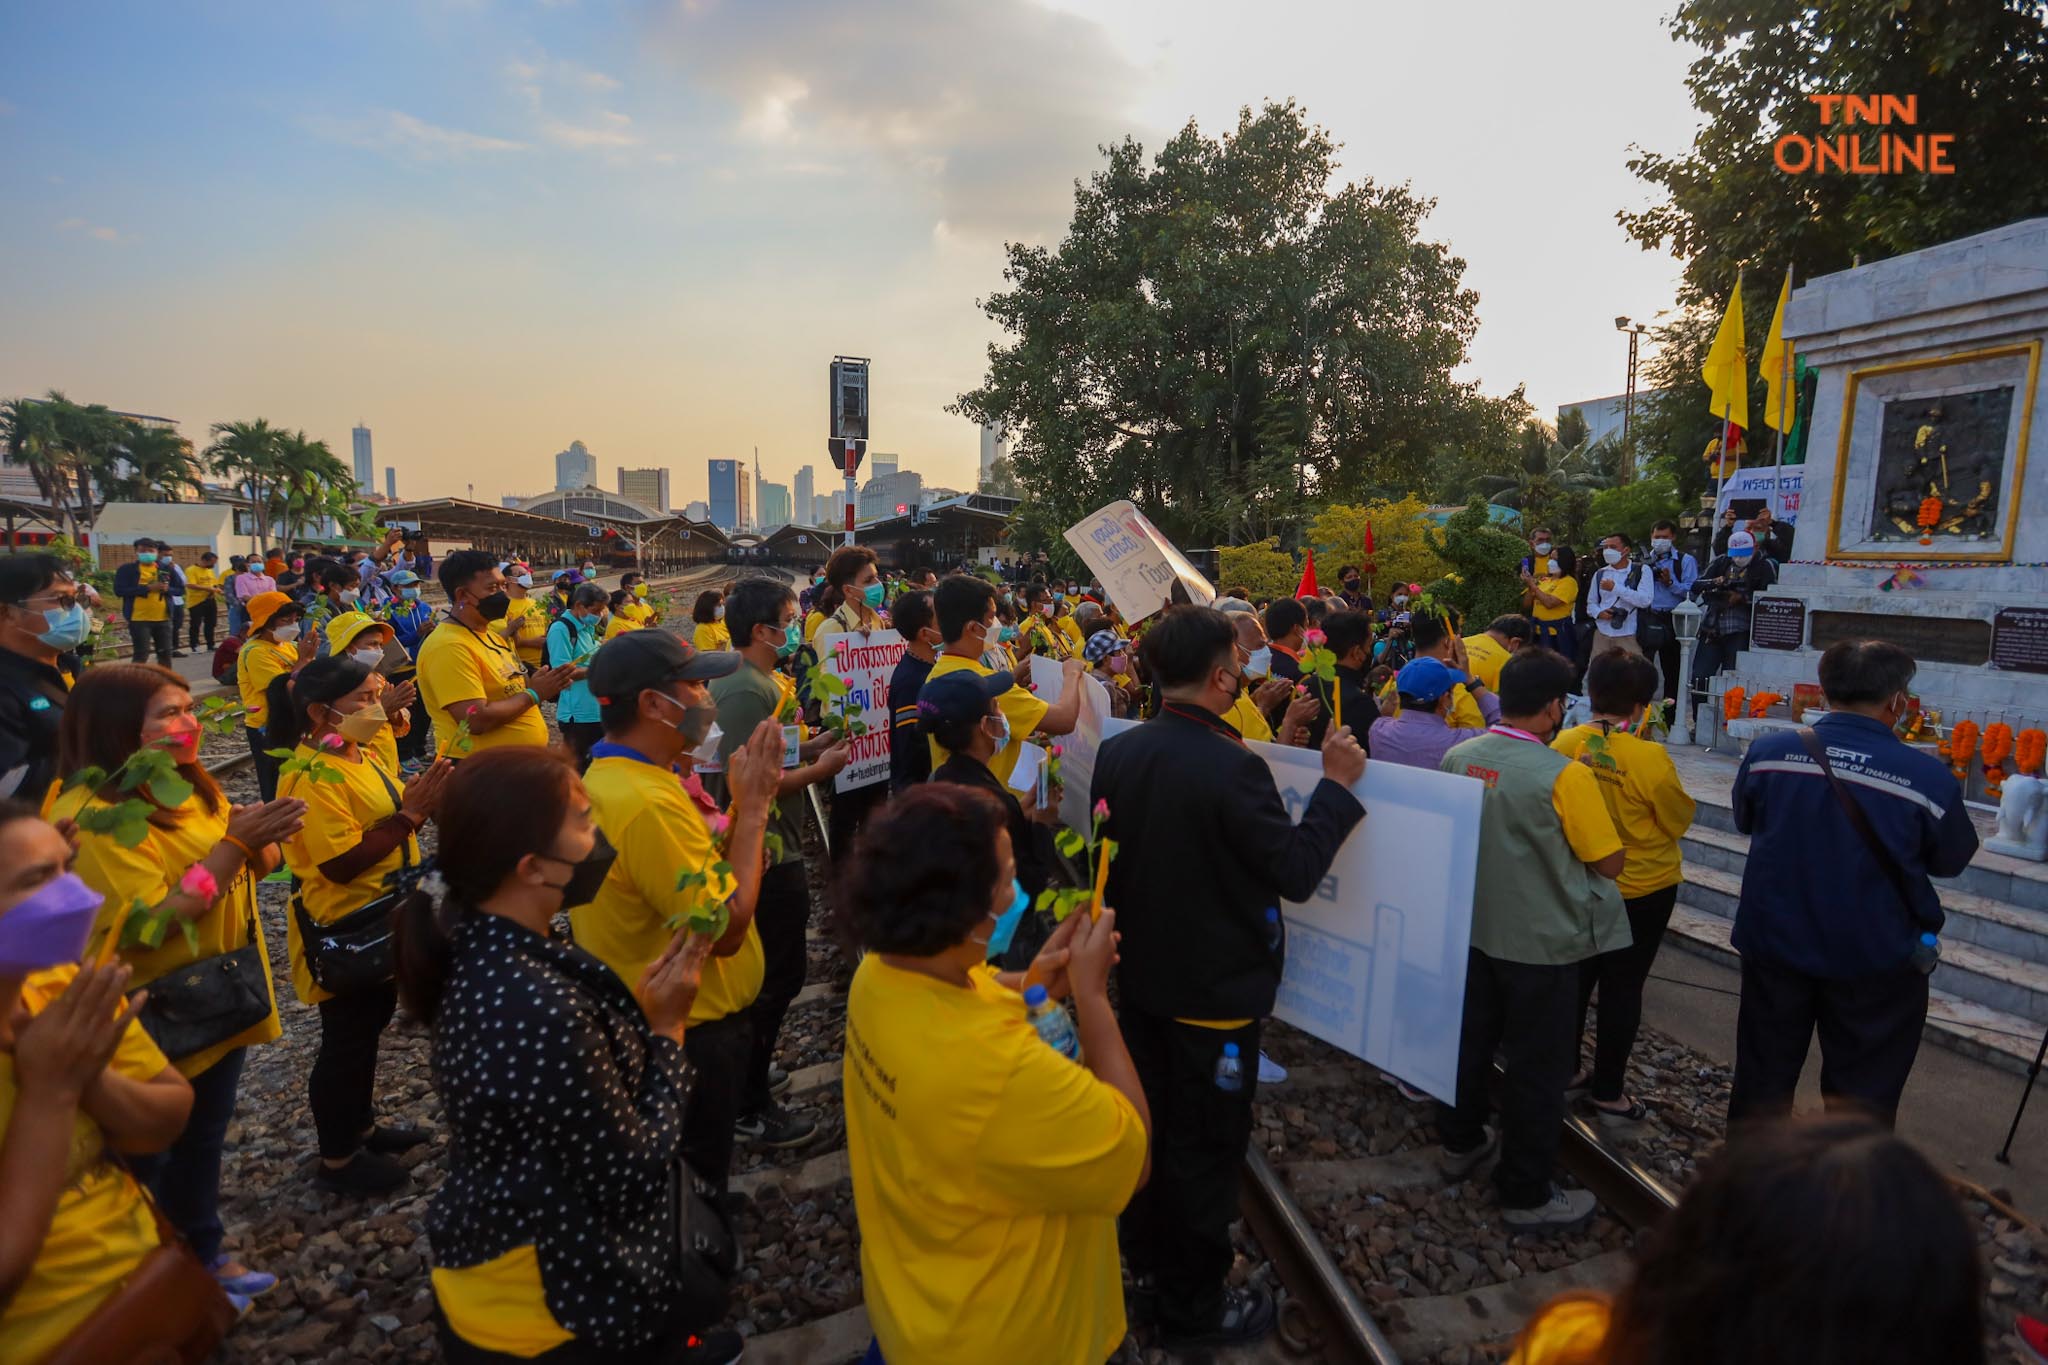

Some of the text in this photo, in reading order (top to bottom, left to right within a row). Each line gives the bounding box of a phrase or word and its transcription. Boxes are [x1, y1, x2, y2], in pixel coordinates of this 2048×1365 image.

[1826, 746, 1872, 764] SRT
[1785, 753, 1809, 763] STATE
[1850, 764, 1864, 772] OF
[1865, 767, 1912, 786] THAILAND
